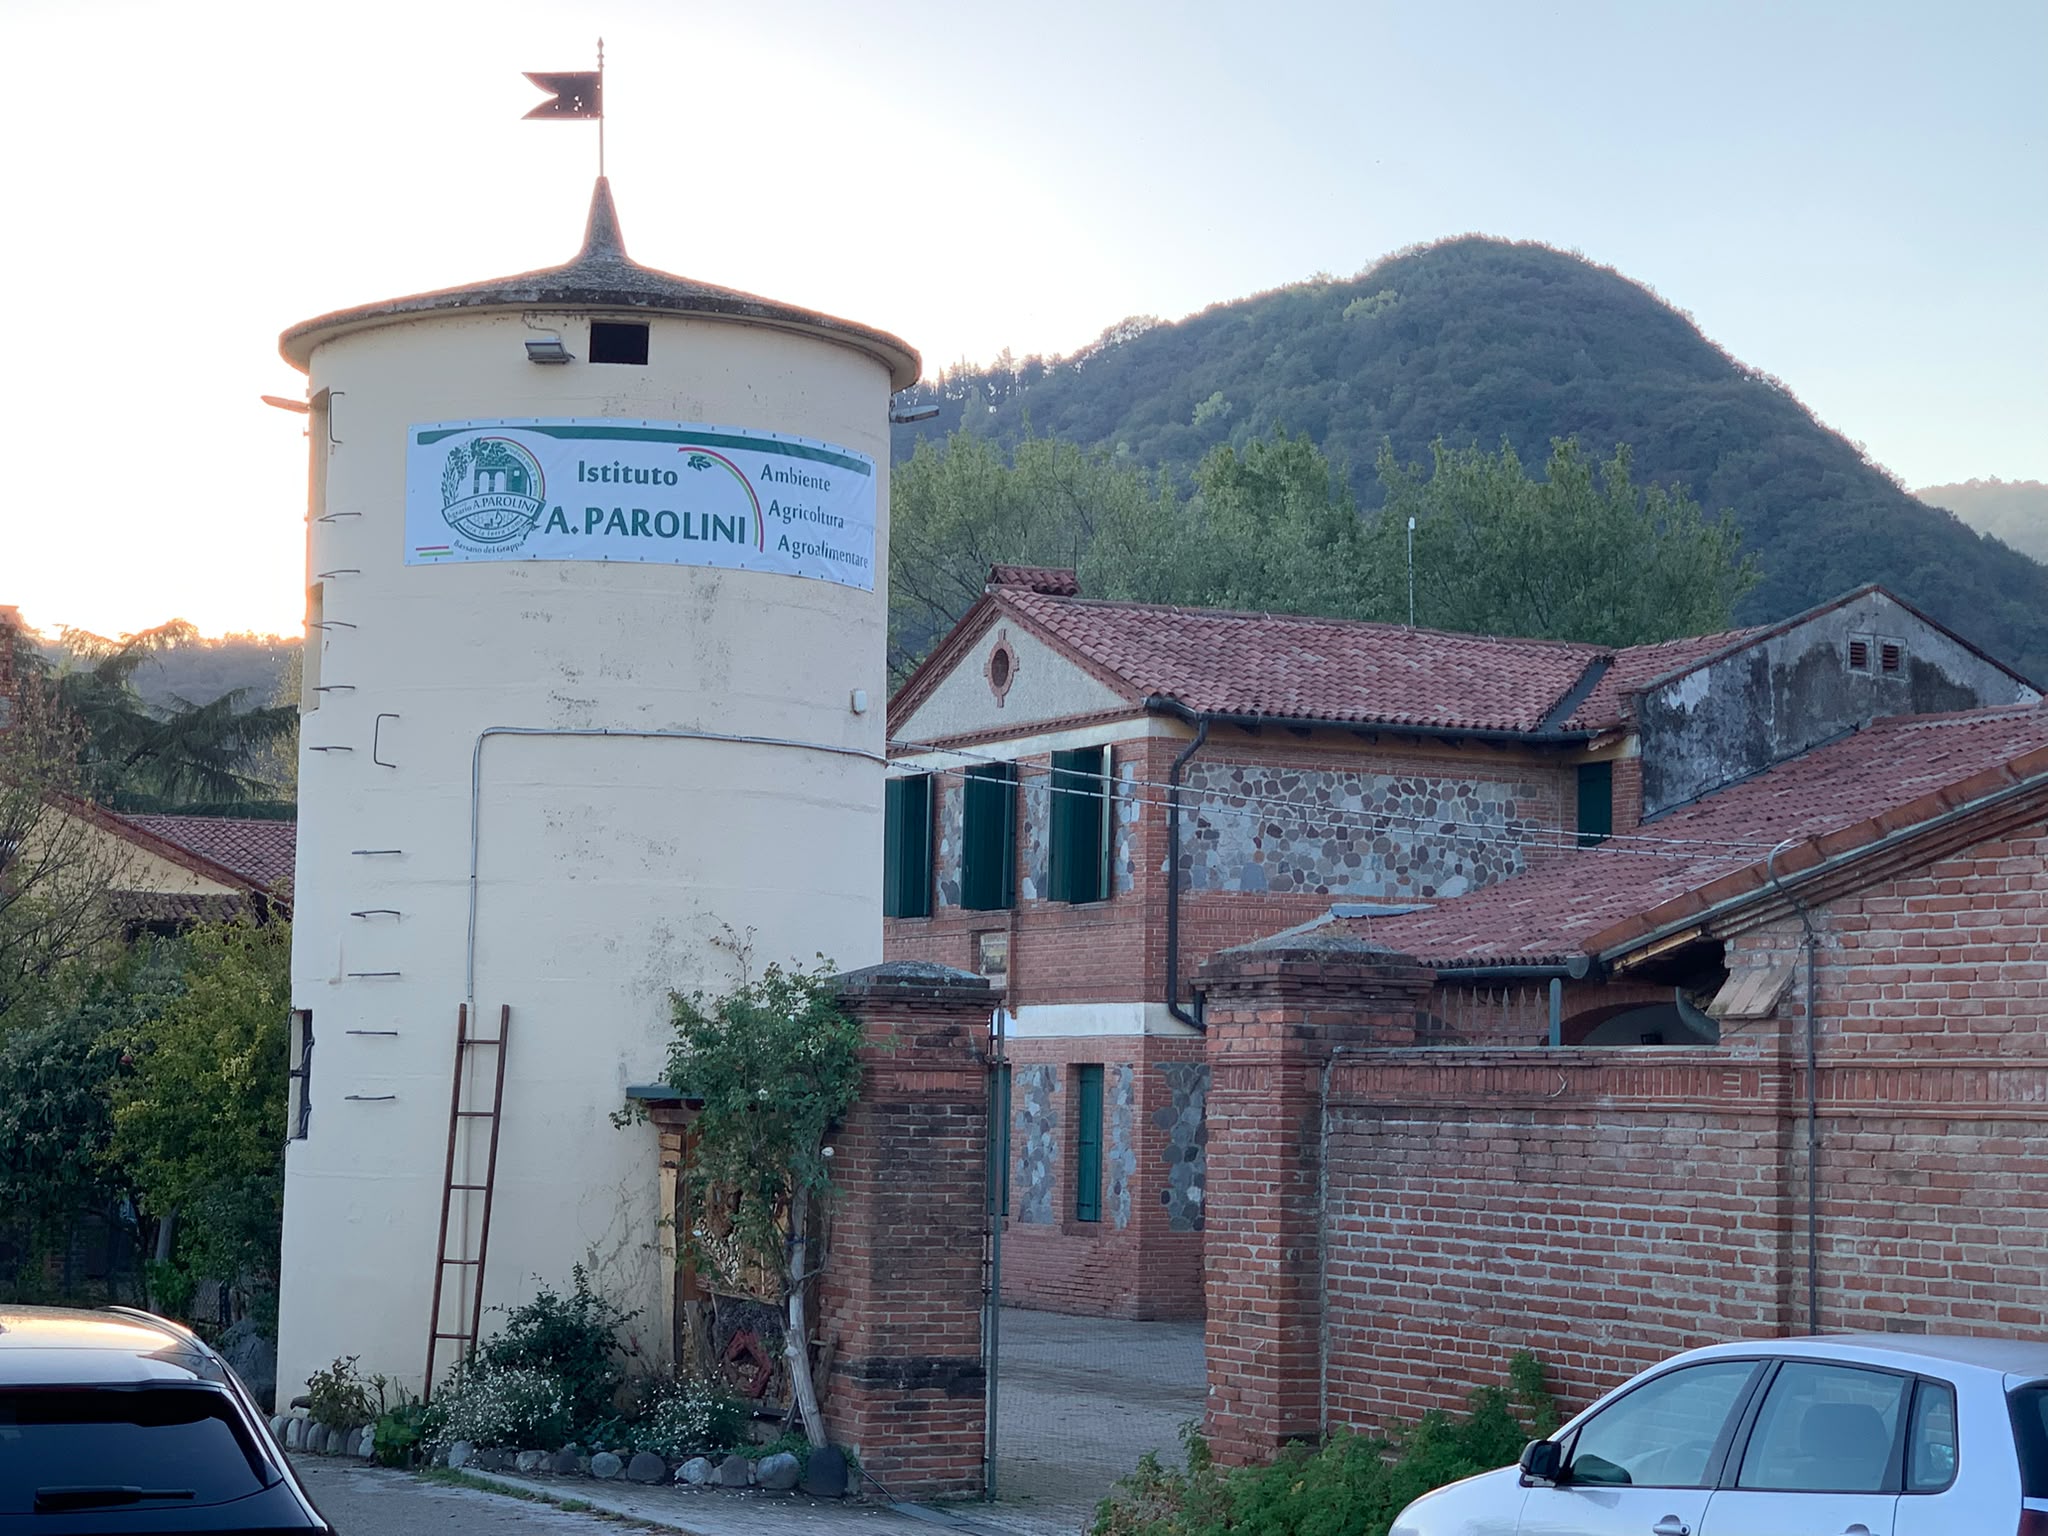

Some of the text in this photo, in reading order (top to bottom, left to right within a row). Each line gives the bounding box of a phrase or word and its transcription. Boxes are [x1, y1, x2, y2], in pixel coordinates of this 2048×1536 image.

[578, 460, 679, 487] Istituto
[760, 463, 832, 493] Ambiente
[768, 499, 845, 529] Agricoltura
[453, 539, 525, 554] Bassano del Grappa
[777, 534, 870, 569] Agroalimentare
